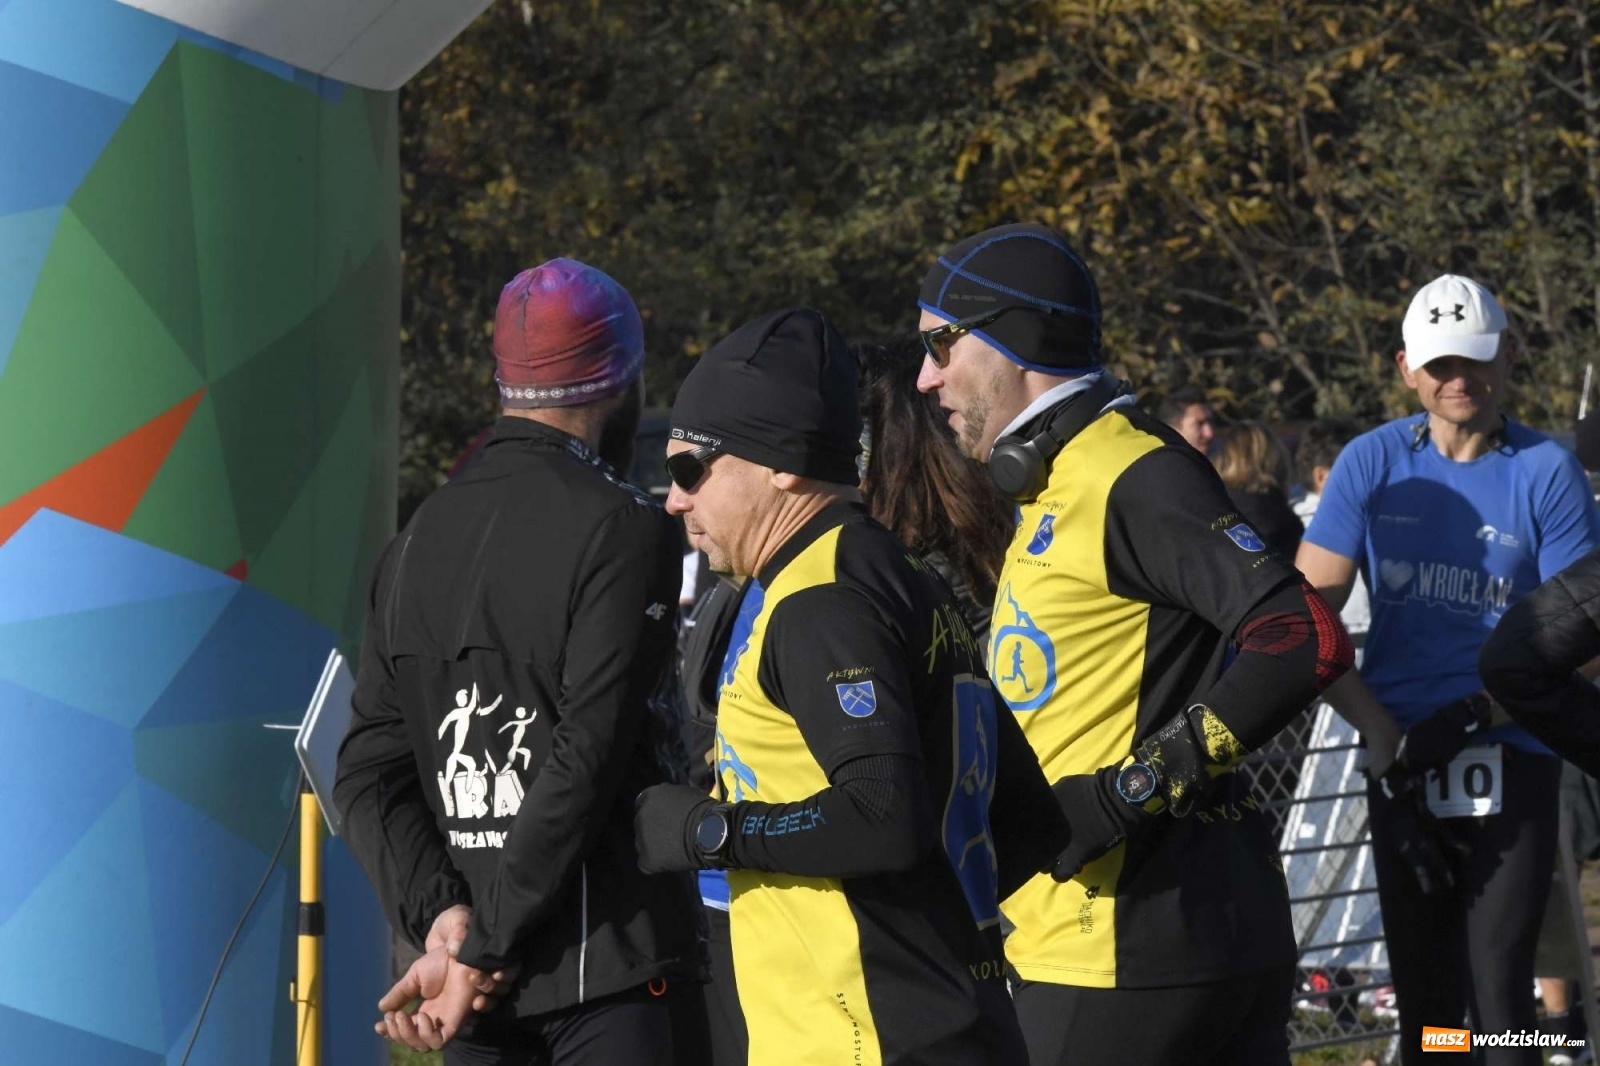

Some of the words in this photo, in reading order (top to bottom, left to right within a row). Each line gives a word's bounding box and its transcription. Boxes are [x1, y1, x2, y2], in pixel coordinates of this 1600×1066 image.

[687, 431, 721, 446] Kalenji
[1419, 562, 1513, 609] WROCŁAW
[645, 602, 667, 620] 4F
